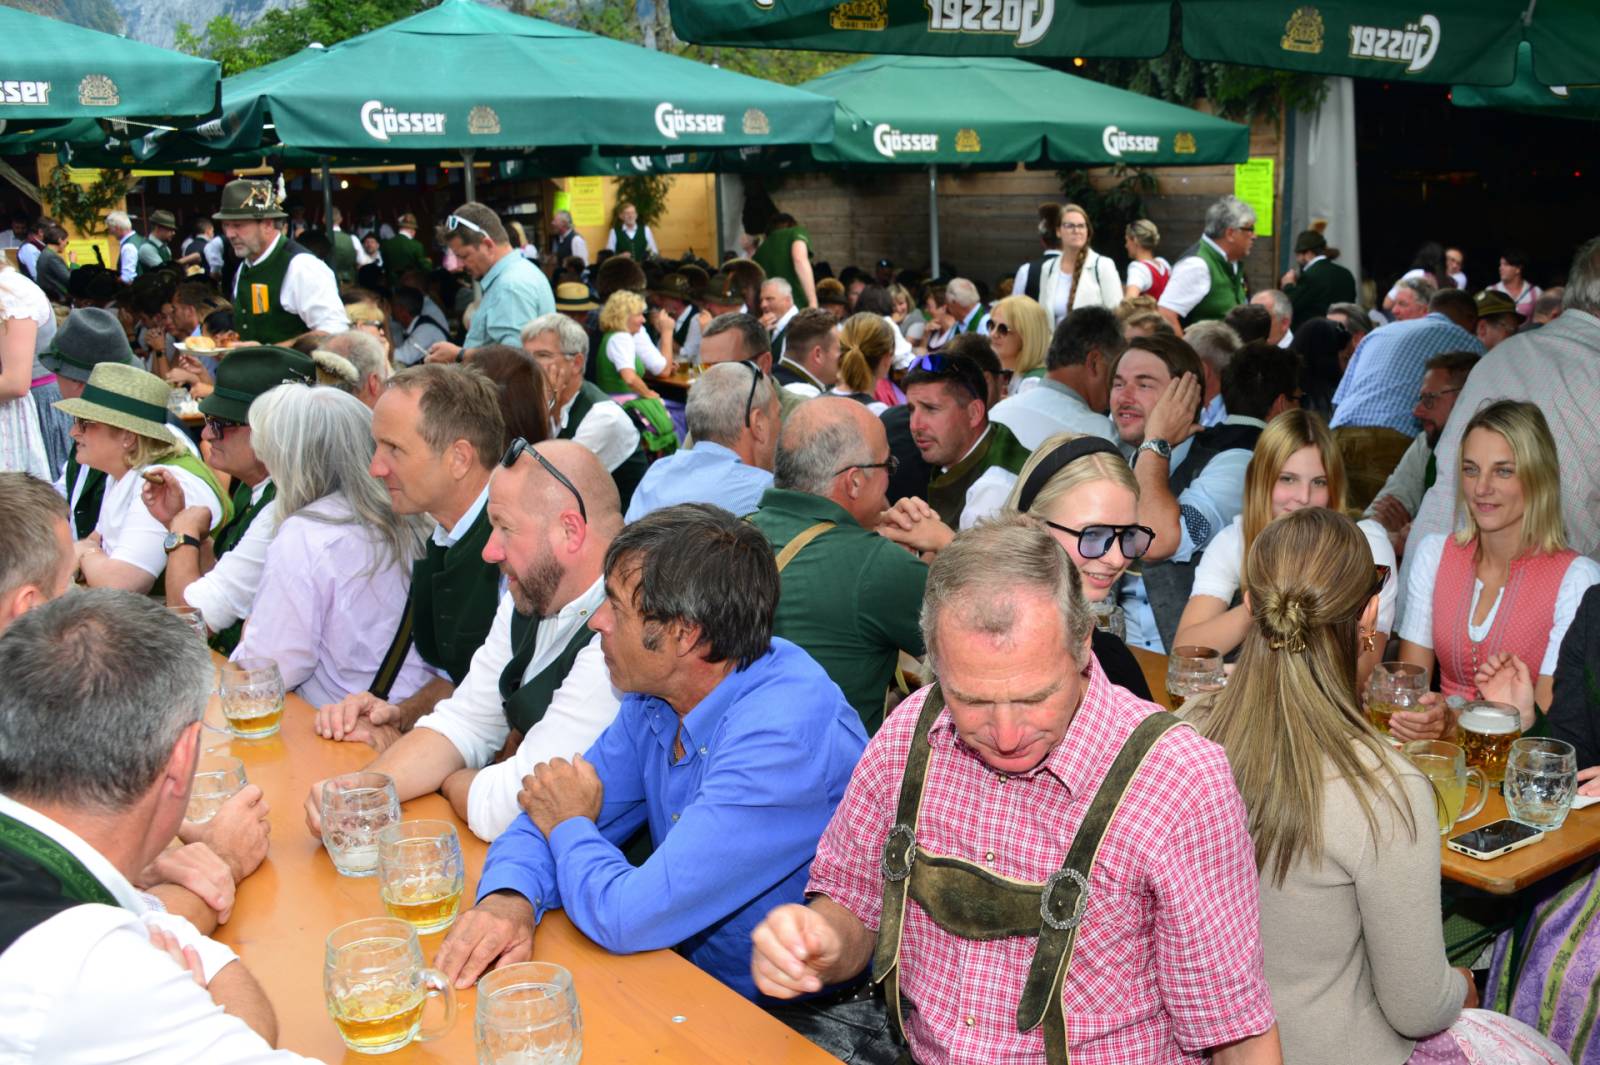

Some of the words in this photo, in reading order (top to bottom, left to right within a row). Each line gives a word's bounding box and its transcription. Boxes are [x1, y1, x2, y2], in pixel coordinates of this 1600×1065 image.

[0, 80, 50, 104] ser
[360, 99, 447, 140] Gösser
[654, 101, 726, 139] Gösser
[873, 123, 939, 158] Gösser
[1102, 124, 1160, 157] Gösser
